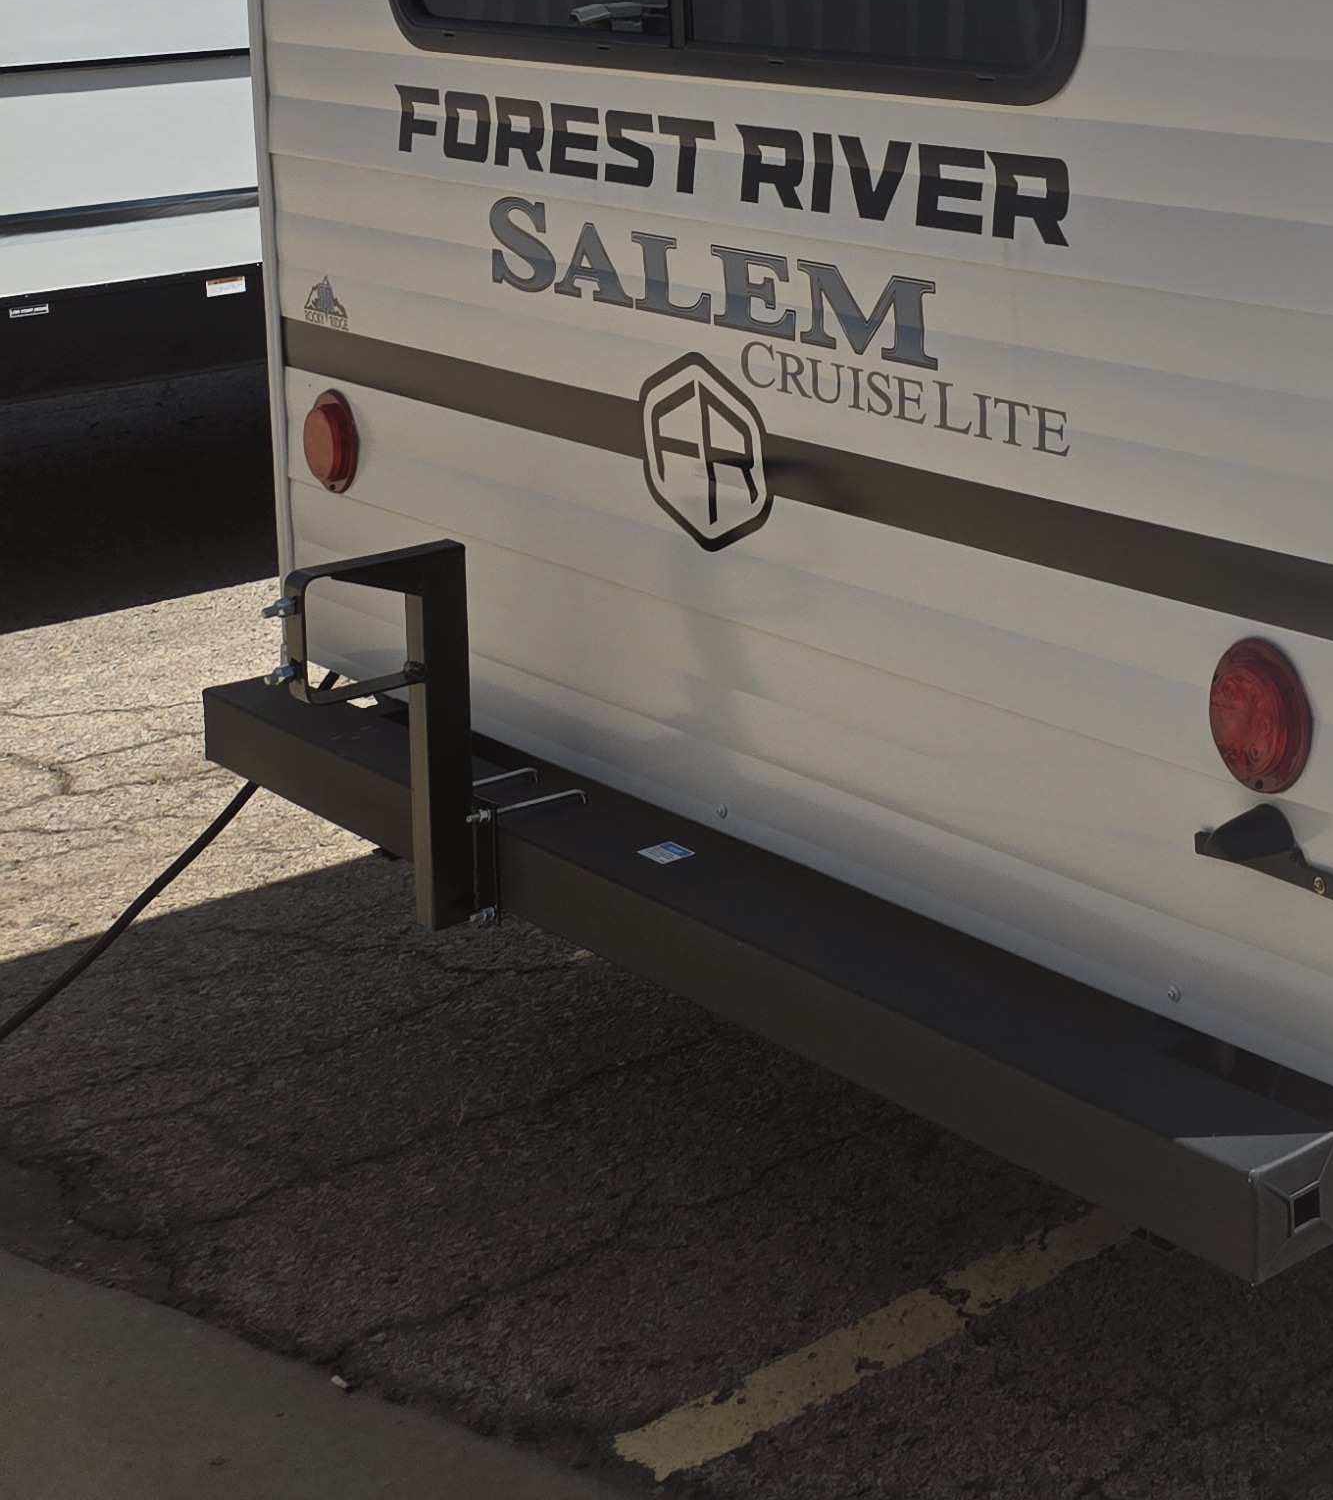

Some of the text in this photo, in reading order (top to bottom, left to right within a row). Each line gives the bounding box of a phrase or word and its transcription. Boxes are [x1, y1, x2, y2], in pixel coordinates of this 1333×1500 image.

[394, 83, 1070, 248] FOREST RIVER
[304, 309, 349, 331] ROCKY RIDGE
[488, 195, 939, 372] SALEM
